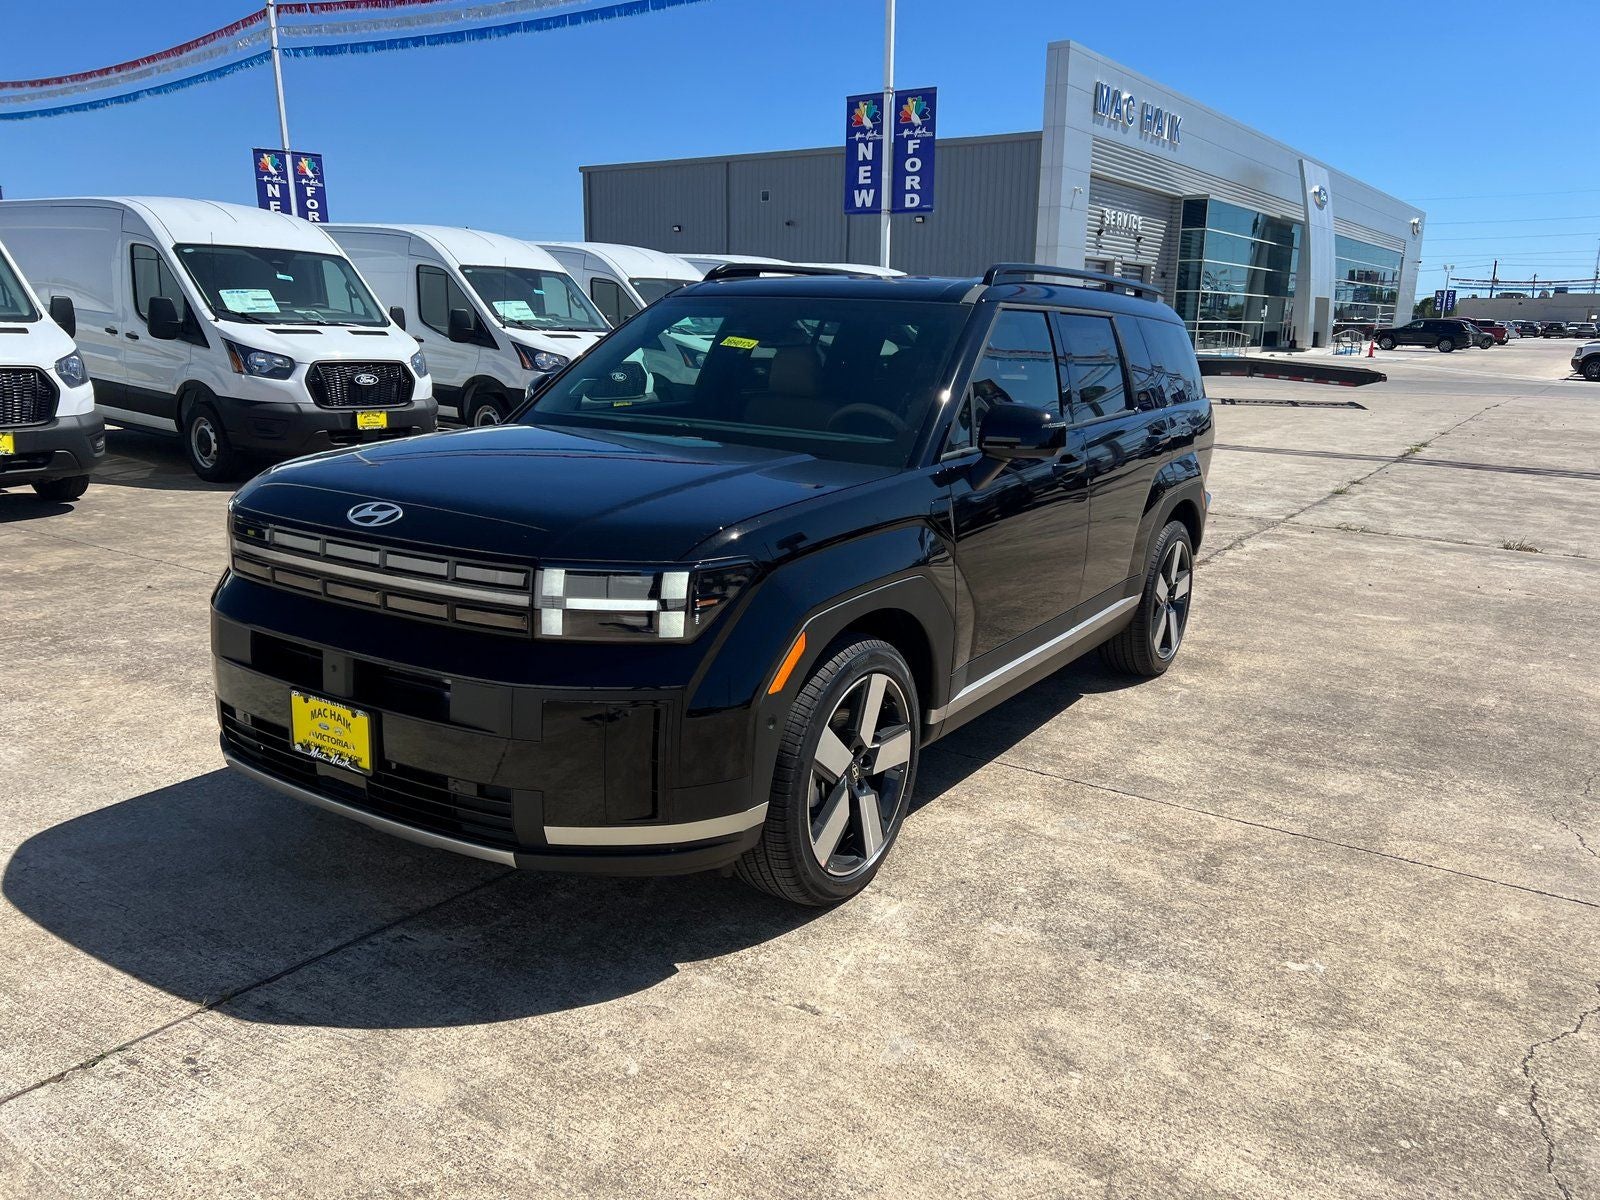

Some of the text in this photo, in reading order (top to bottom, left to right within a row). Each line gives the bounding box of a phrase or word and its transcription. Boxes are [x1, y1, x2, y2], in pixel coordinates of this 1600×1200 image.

[1094, 80, 1183, 145] MAC HAIK
[853, 142, 875, 208] NEW
[904, 139, 922, 208] FORD
[266, 184, 281, 213] NE
[306, 186, 321, 222] FOR
[1104, 209, 1143, 230] SERVICE
[358, 375, 376, 384] Ford
[310, 708, 328, 721] MAC
[330, 710, 352, 732] HAIK
[315, 731, 350, 750] VICTORIA
[309, 746, 350, 767] Mac Haik
